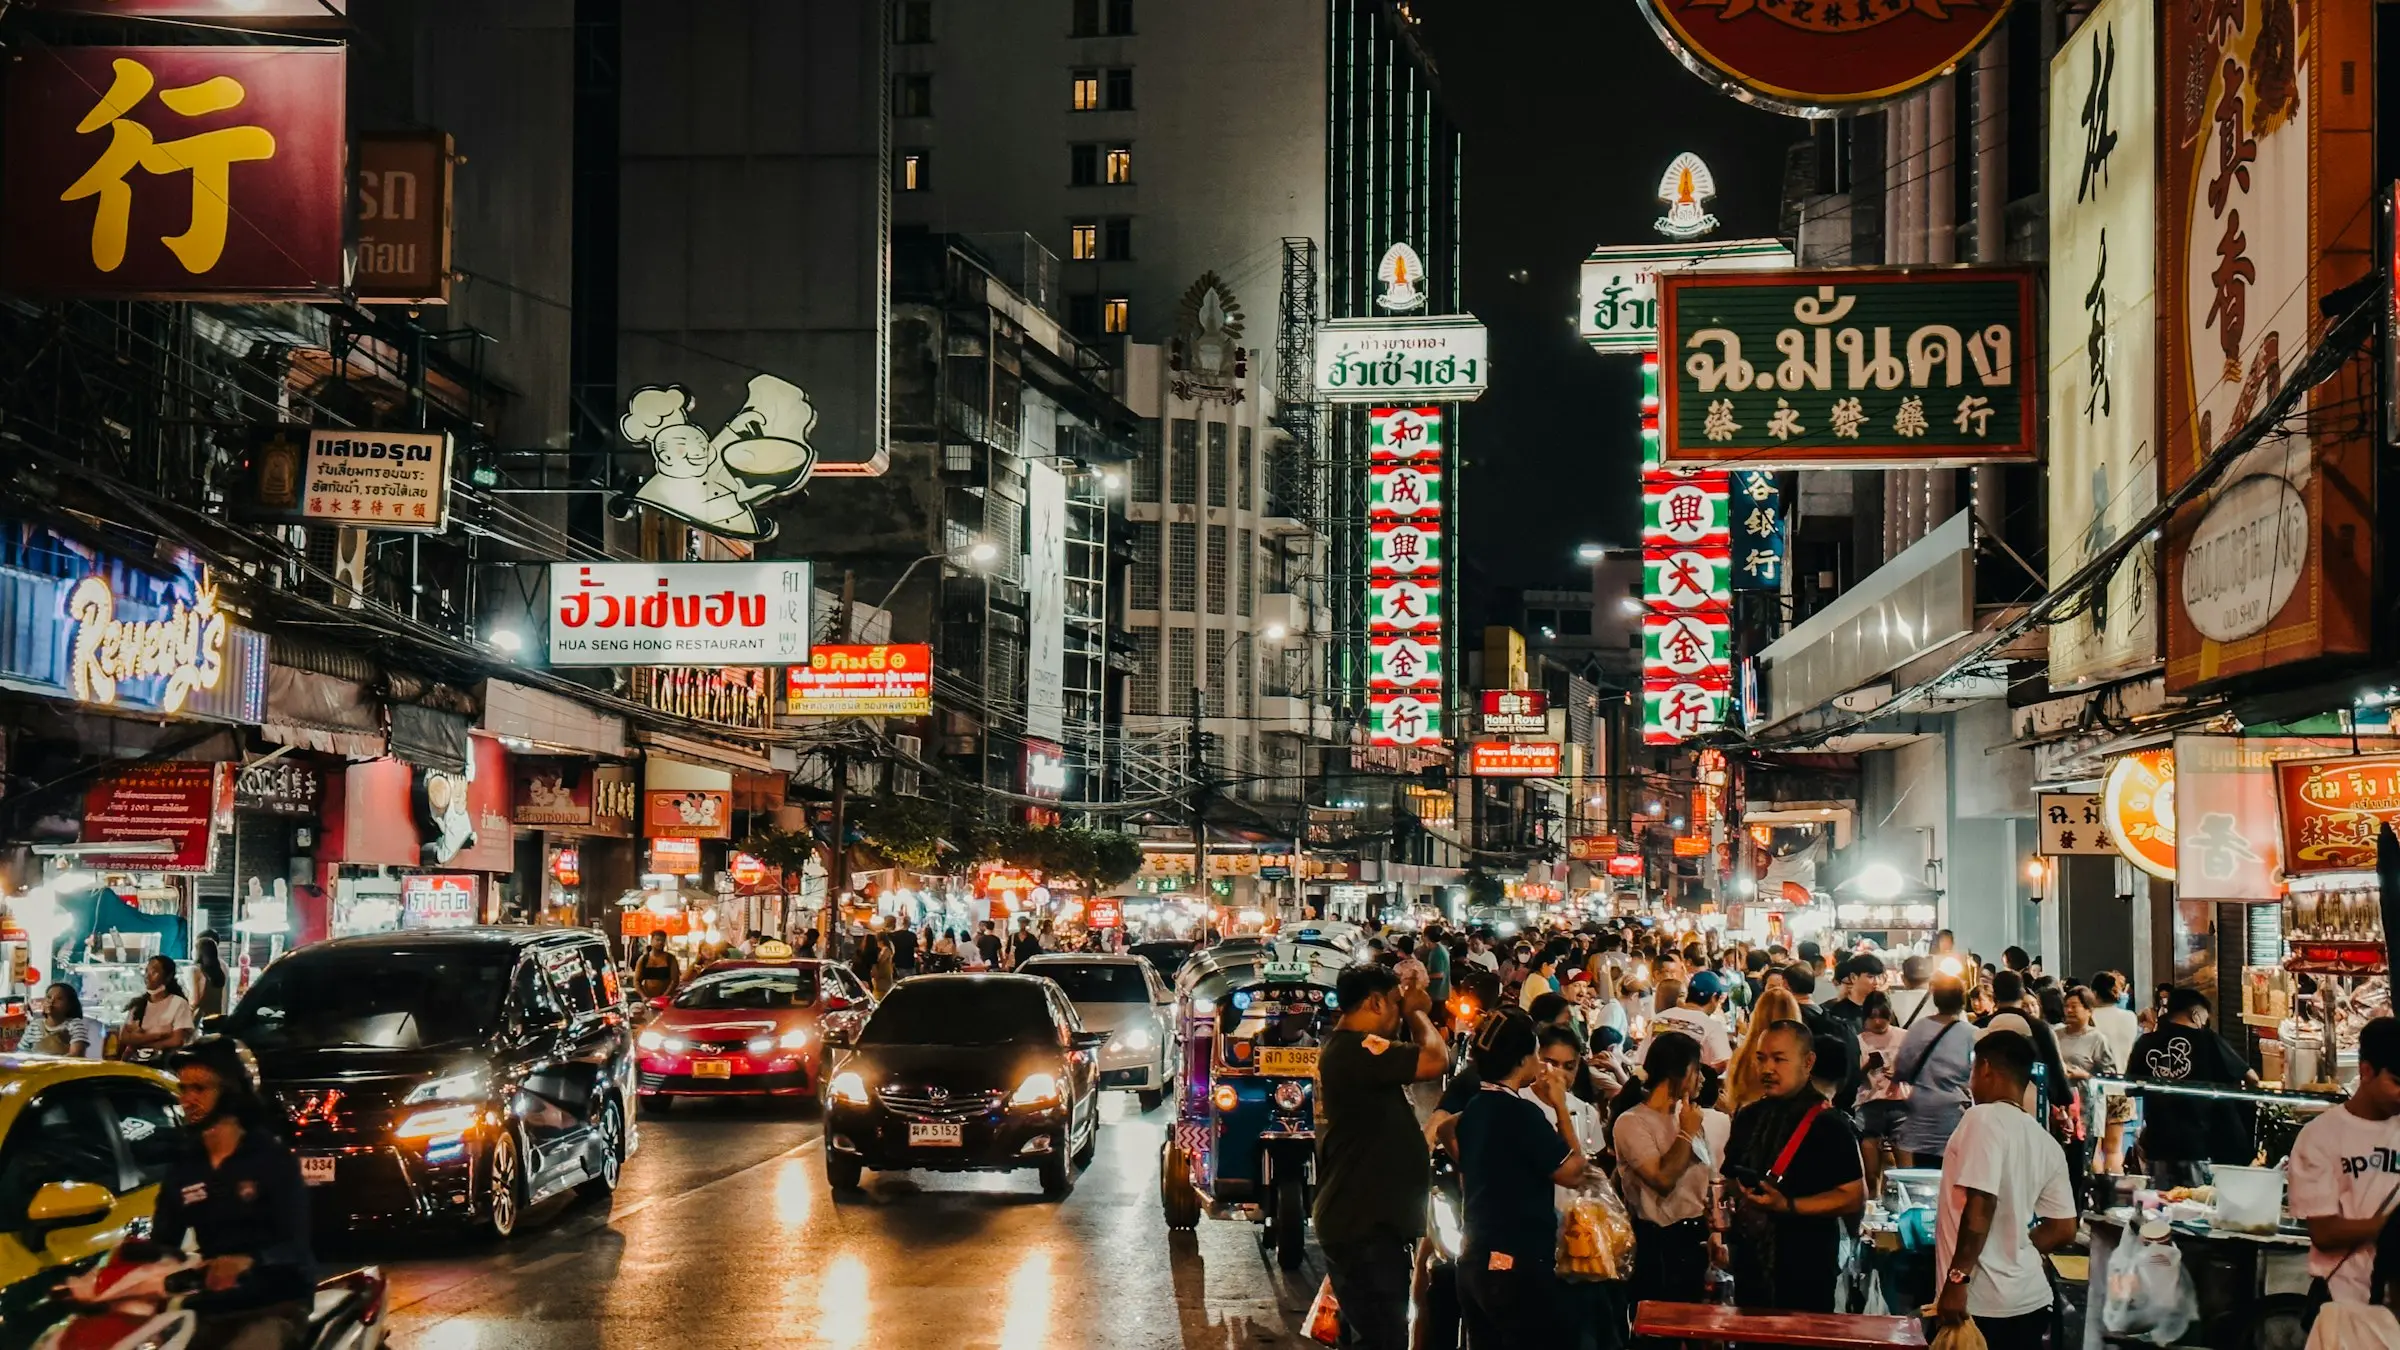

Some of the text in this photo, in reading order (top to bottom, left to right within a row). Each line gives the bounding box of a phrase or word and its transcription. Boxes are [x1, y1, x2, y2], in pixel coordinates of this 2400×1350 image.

[60, 58, 276, 273] 行
[1686, 285, 2012, 392] ฉ.มั่นคง
[1704, 396, 1995, 441] 蔡永發藥行
[315, 439, 432, 466] แสงอรุณ
[1388, 416, 1424, 740] 和成興大金行
[560, 567, 766, 629] ฮั่วเซ่งฮง
[559, 638, 765, 651] HUA SENG HONG RESTAURANT
[1484, 714, 1545, 726] Hotel Royal
[2308, 765, 2340, 799] ลิ้ม
[764, 945, 782, 953] TAXI
[1271, 964, 1303, 973] TAXI
[1288, 1052, 1317, 1064] 3985
[932, 1125, 959, 1136] 5152
[304, 1159, 332, 1171] 4334
